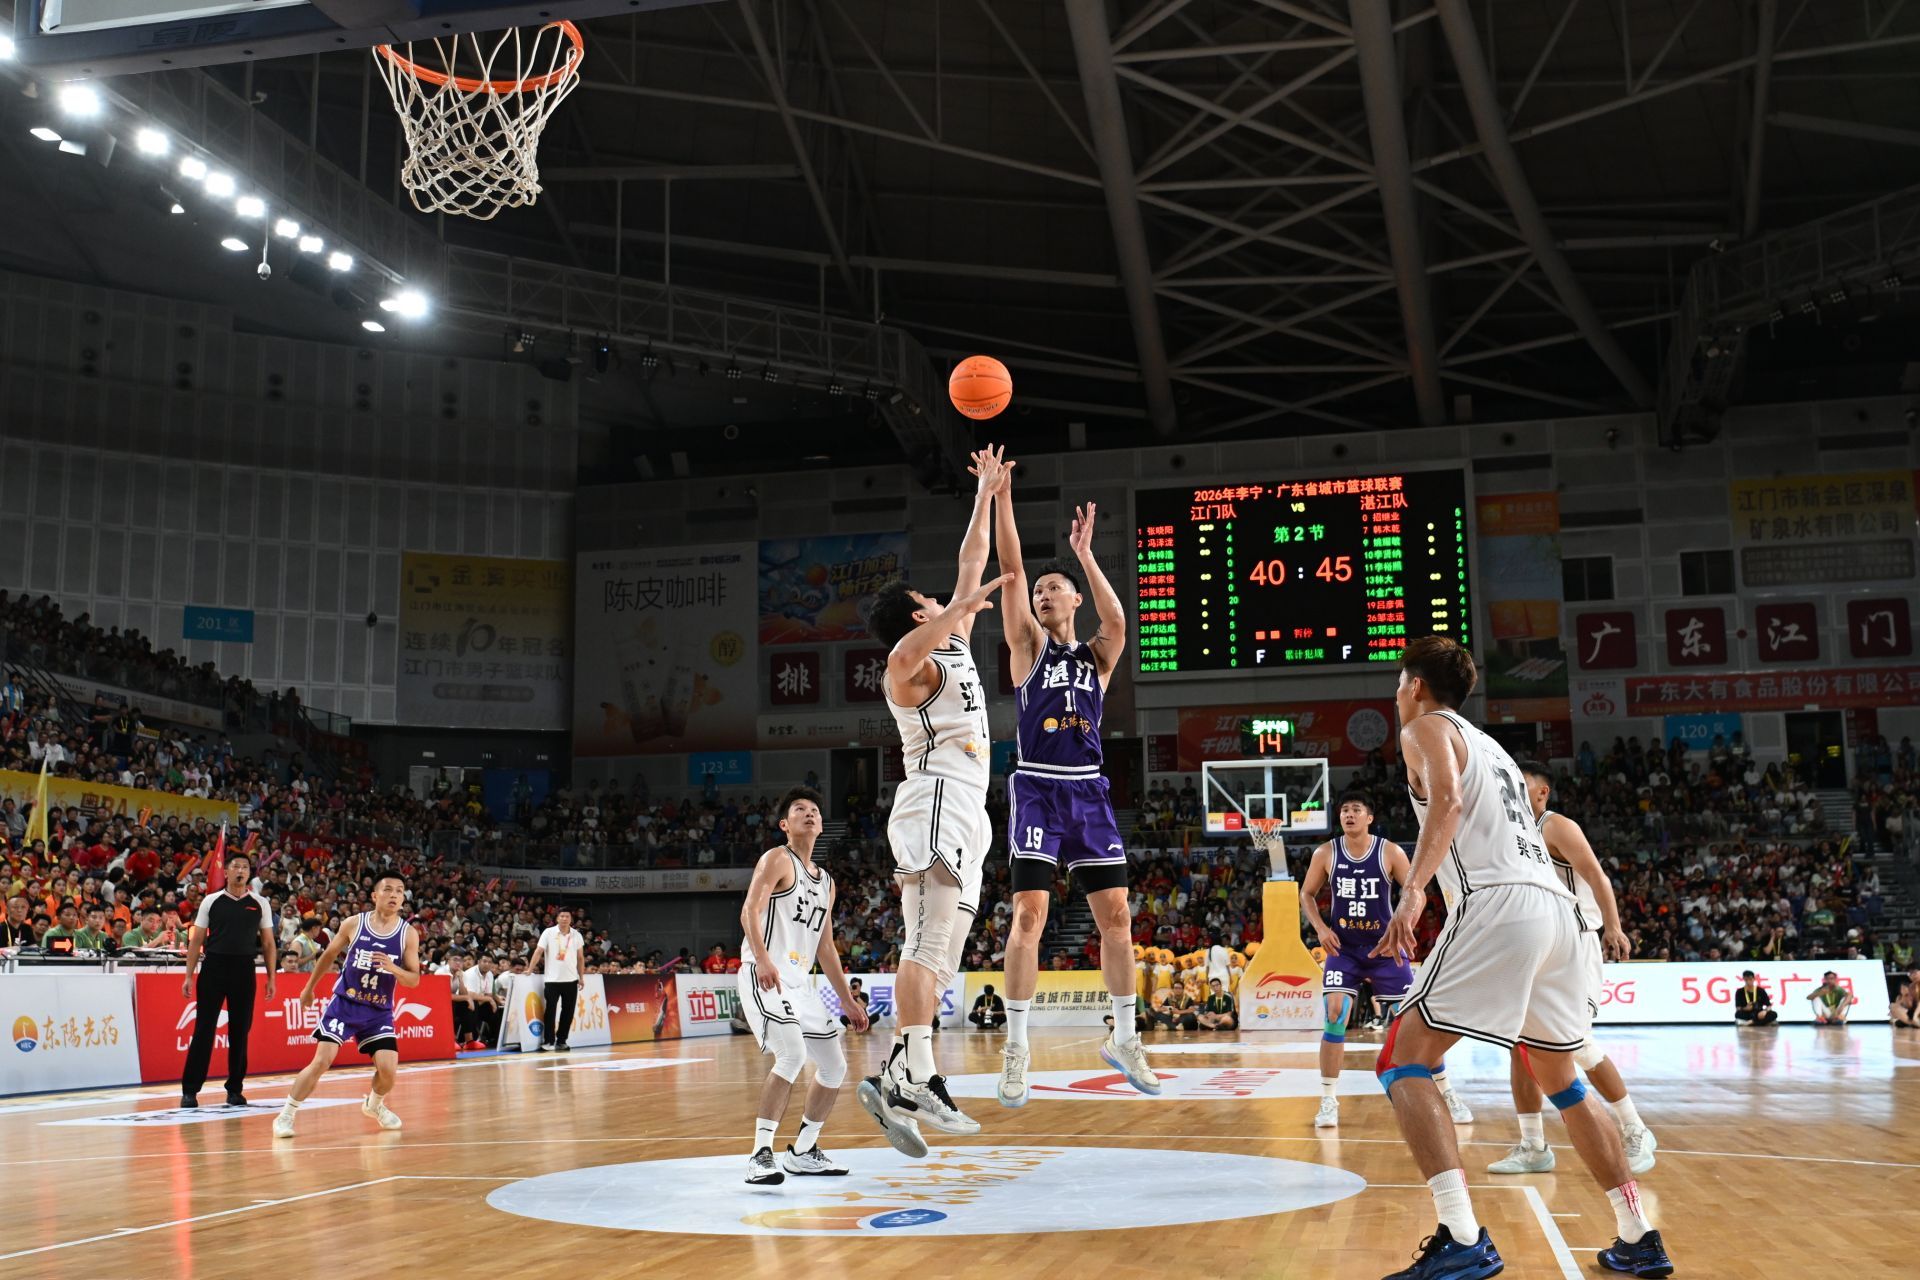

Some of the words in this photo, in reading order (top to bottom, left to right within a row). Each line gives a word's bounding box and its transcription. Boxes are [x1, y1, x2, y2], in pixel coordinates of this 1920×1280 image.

[1190, 504, 1237, 520] 江门队
[1360, 493, 1408, 510] 湛江队
[1750, 511, 1899, 539] 矿泉水有限公司
[1249, 560, 1285, 585] 40
[1316, 556, 1352, 582] 45
[604, 572, 727, 613] 陈皮咖啡
[197, 617, 221, 631] 201
[1585, 621, 1621, 663] 广
[1677, 616, 1712, 658] 东
[1767, 617, 1808, 651] 江
[1861, 610, 1896, 647] 门
[777, 661, 812, 697] 排
[853, 658, 886, 693] 球
[1042, 660, 1095, 692] 湛江
[1679, 724, 1707, 739] 120
[1259, 733, 1281, 754] 14
[700, 761, 724, 775] 123
[1025, 826, 1043, 850] 19
[595, 875, 646, 889] 陈皮咖啡
[1336, 877, 1380, 899] 湛江
[1348, 901, 1366, 917] 26
[361, 973, 379, 990] 44
[1325, 970, 1343, 986] 26
[1255, 990, 1313, 1000] LI-NING
[329, 1018, 345, 1036] 44
